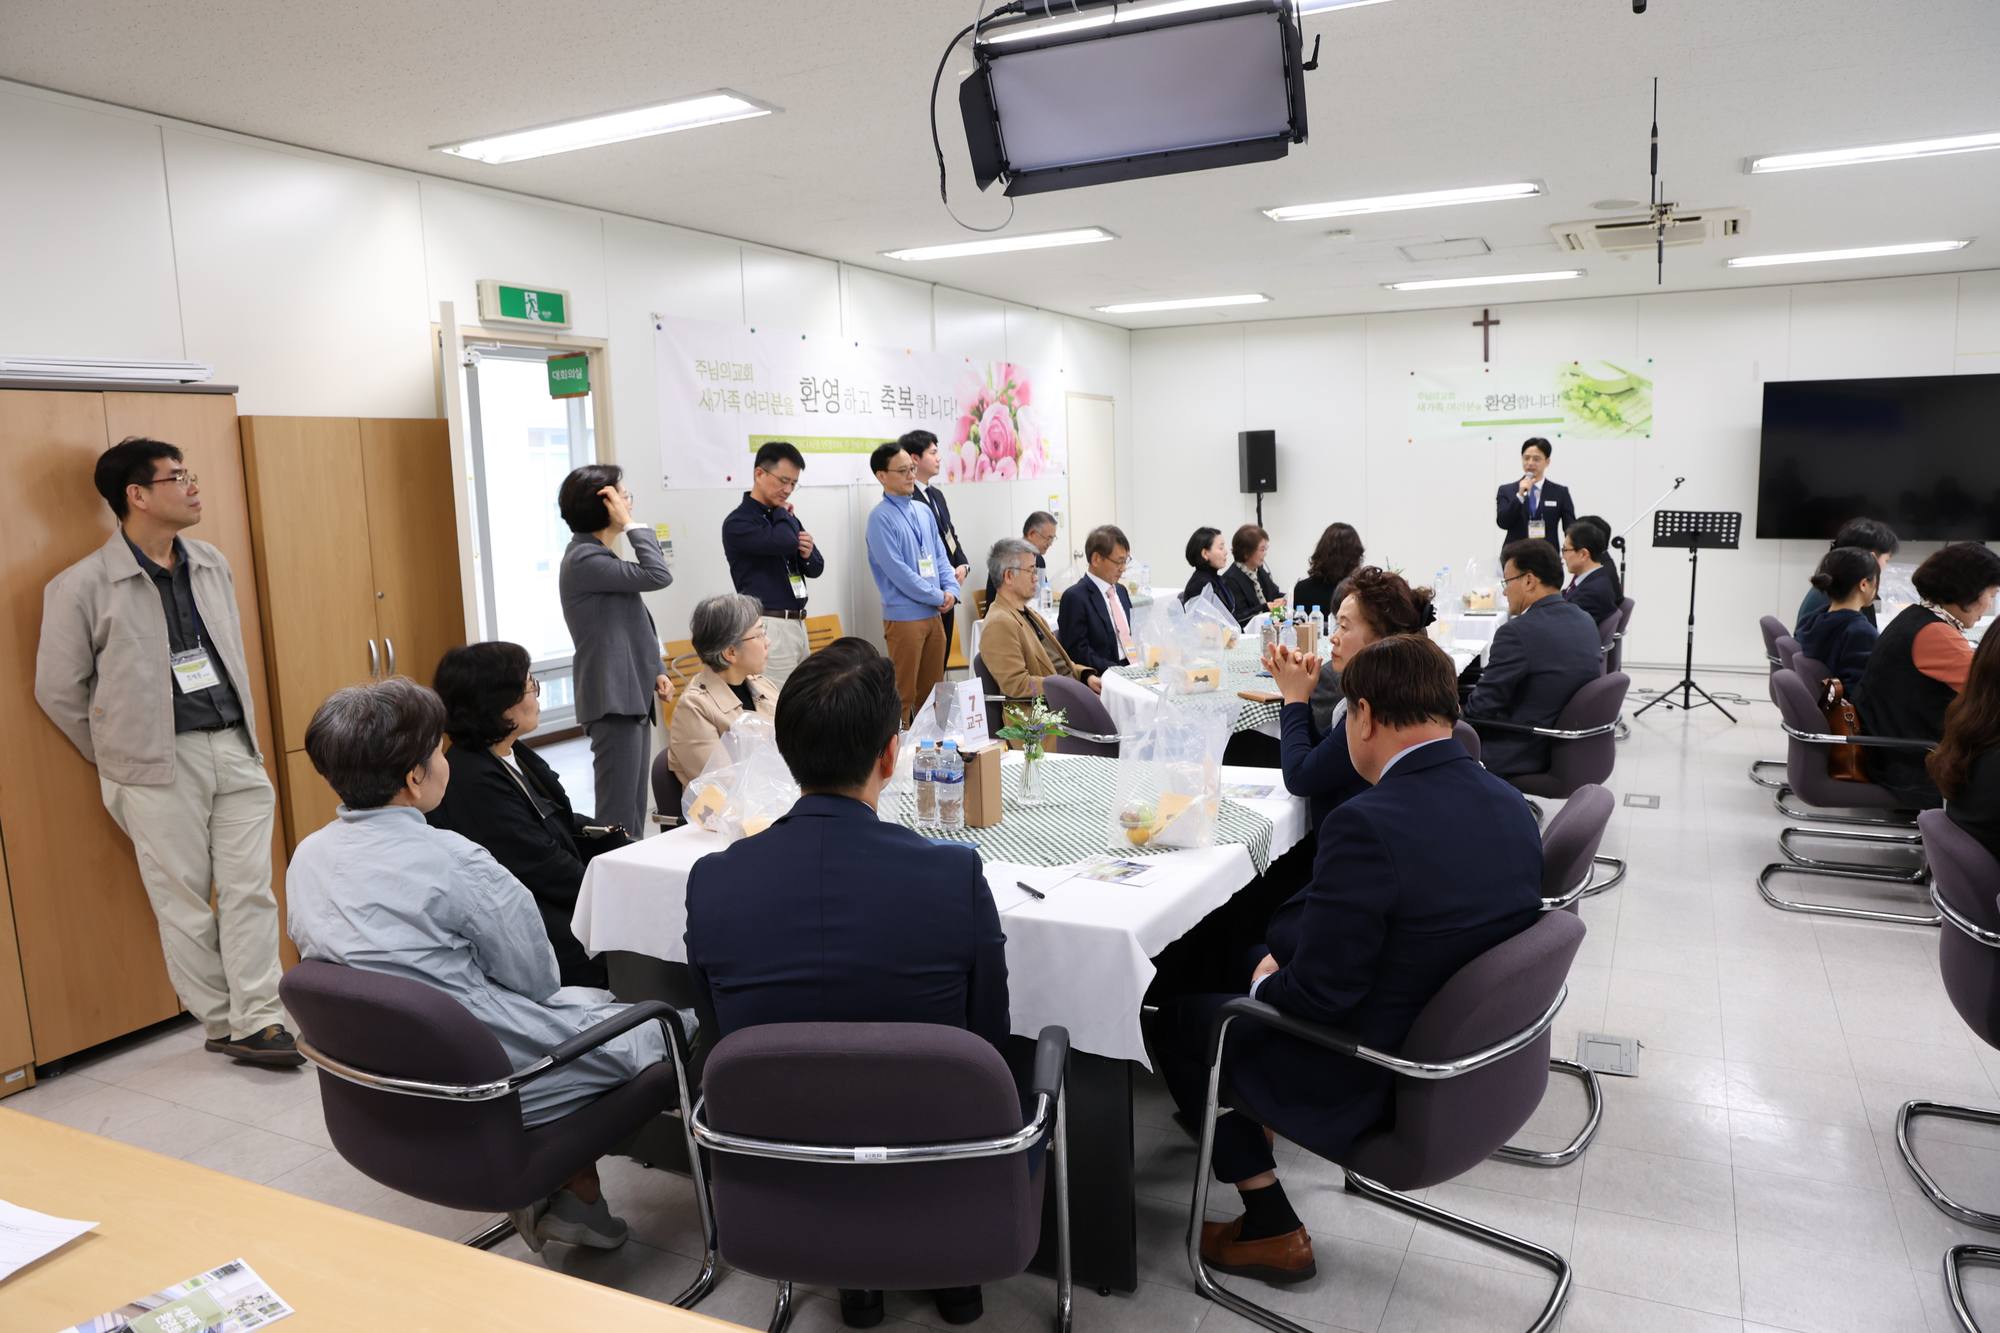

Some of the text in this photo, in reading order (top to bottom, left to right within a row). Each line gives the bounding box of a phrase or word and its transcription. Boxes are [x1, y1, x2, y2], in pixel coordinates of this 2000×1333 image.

[696, 359, 754, 382] 주님의교회
[698, 376, 959, 420] 새가족 여러분을 환영하고 축복합니다!
[1485, 393, 1561, 412] 환영합니다!
[968, 694, 976, 712] 7
[966, 713, 983, 730] 교구
